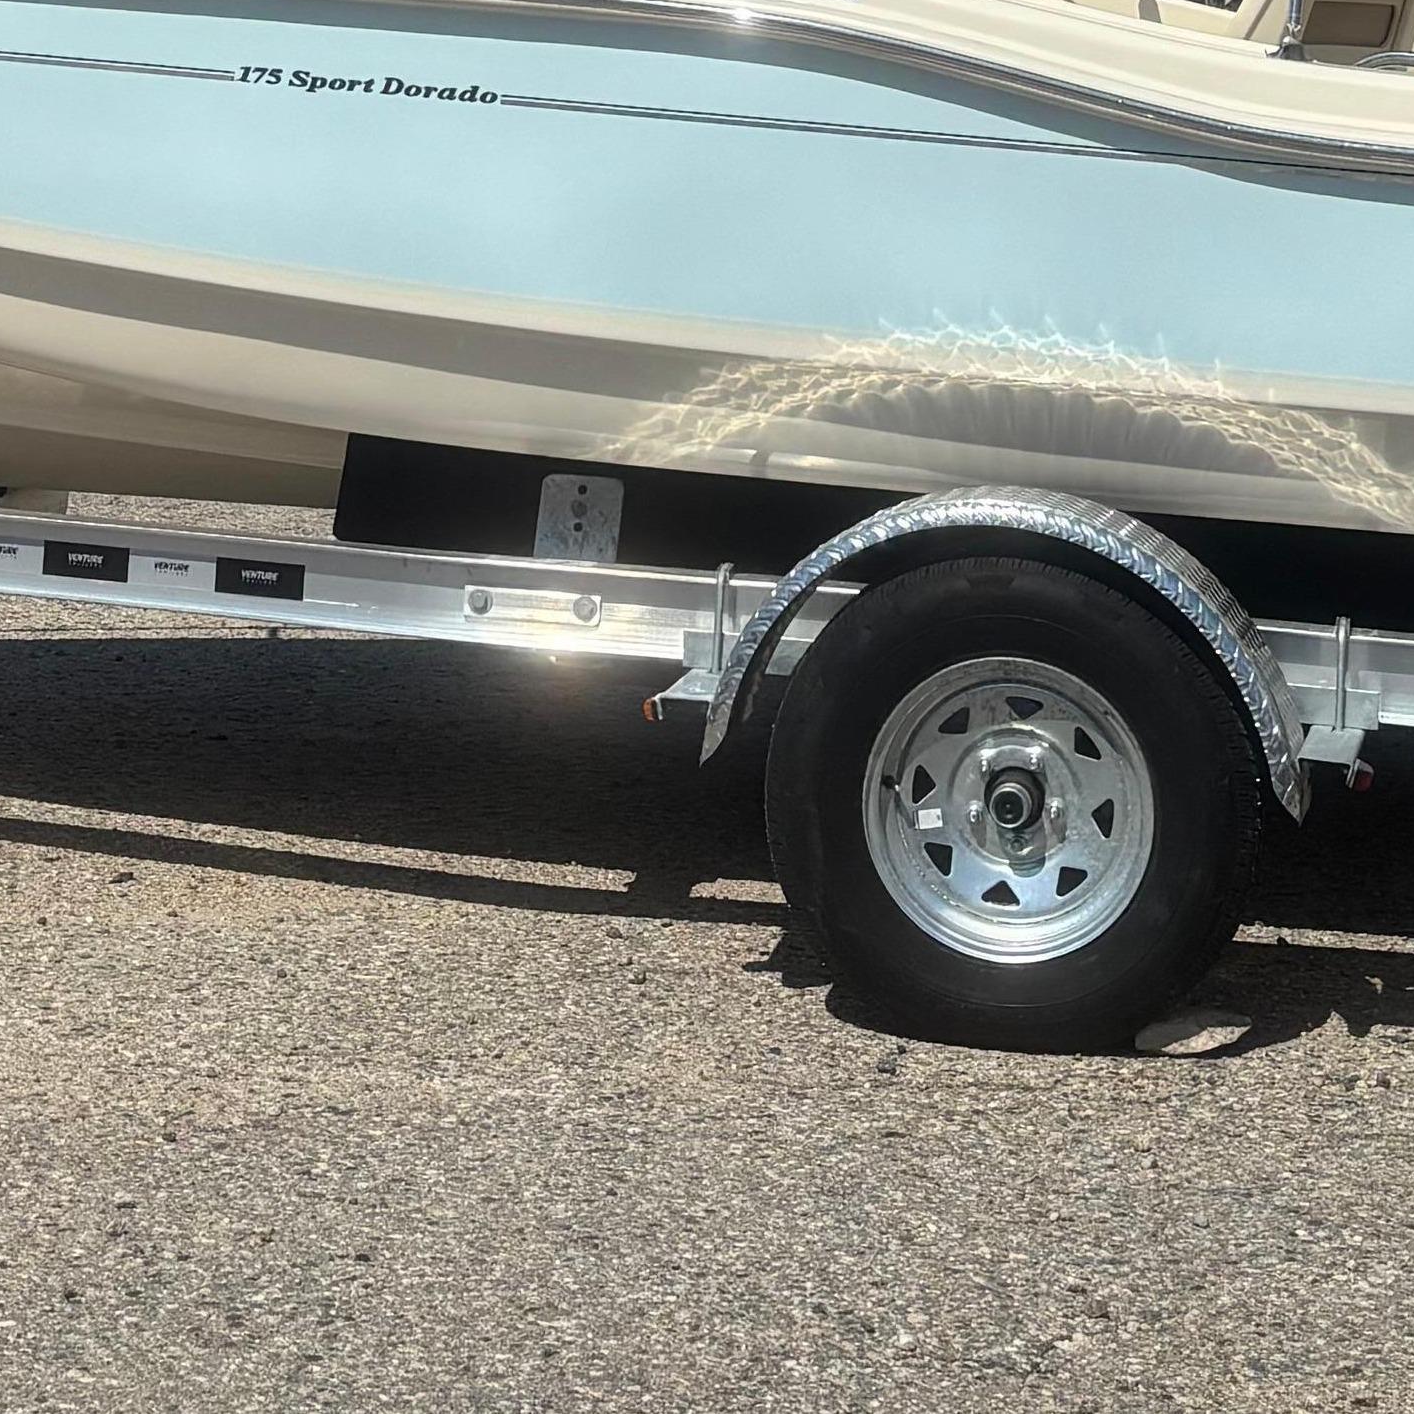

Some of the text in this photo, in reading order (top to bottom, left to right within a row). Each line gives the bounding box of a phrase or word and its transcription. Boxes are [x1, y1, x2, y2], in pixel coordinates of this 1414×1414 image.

[238, 65, 499, 104] 175 Sport Dorado
[68, 551, 104, 564] VENTURE
[241, 568, 278, 581] VENTURE
